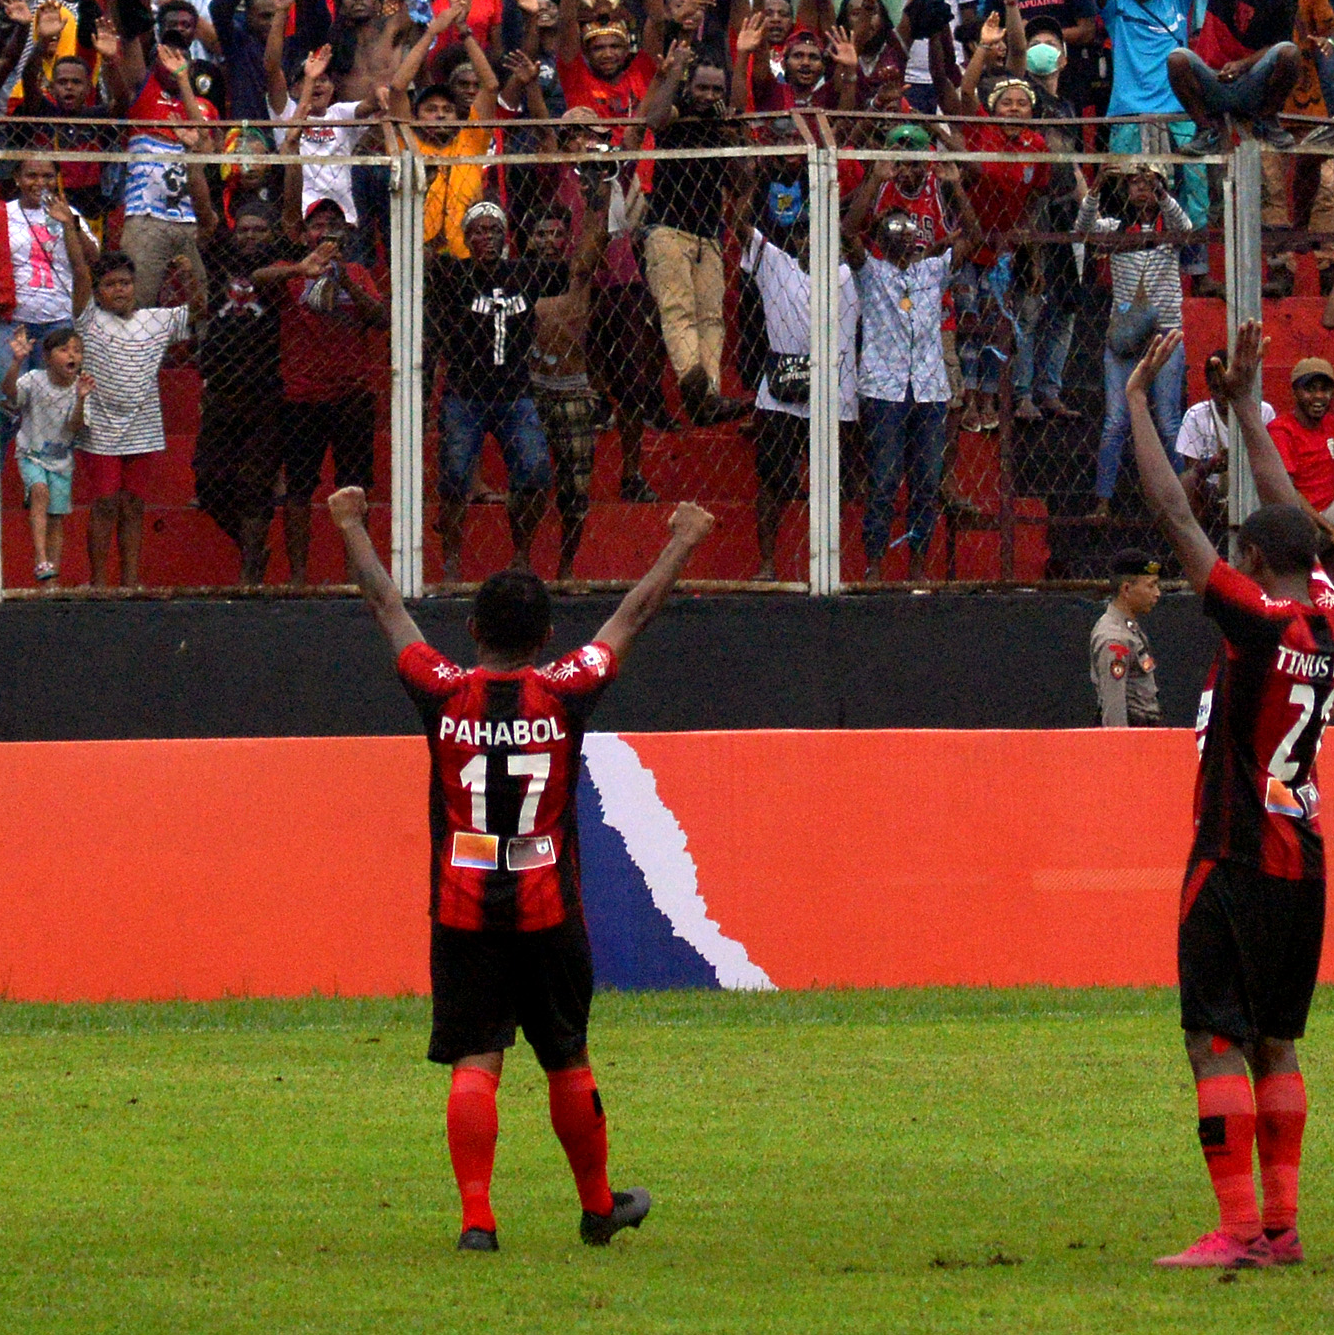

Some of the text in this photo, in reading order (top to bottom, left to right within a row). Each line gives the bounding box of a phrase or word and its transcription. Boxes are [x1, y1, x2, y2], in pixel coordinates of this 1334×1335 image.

[1276, 644, 1331, 678] TINUS
[439, 716, 566, 746] PAHABOL
[458, 752, 551, 835] 17
